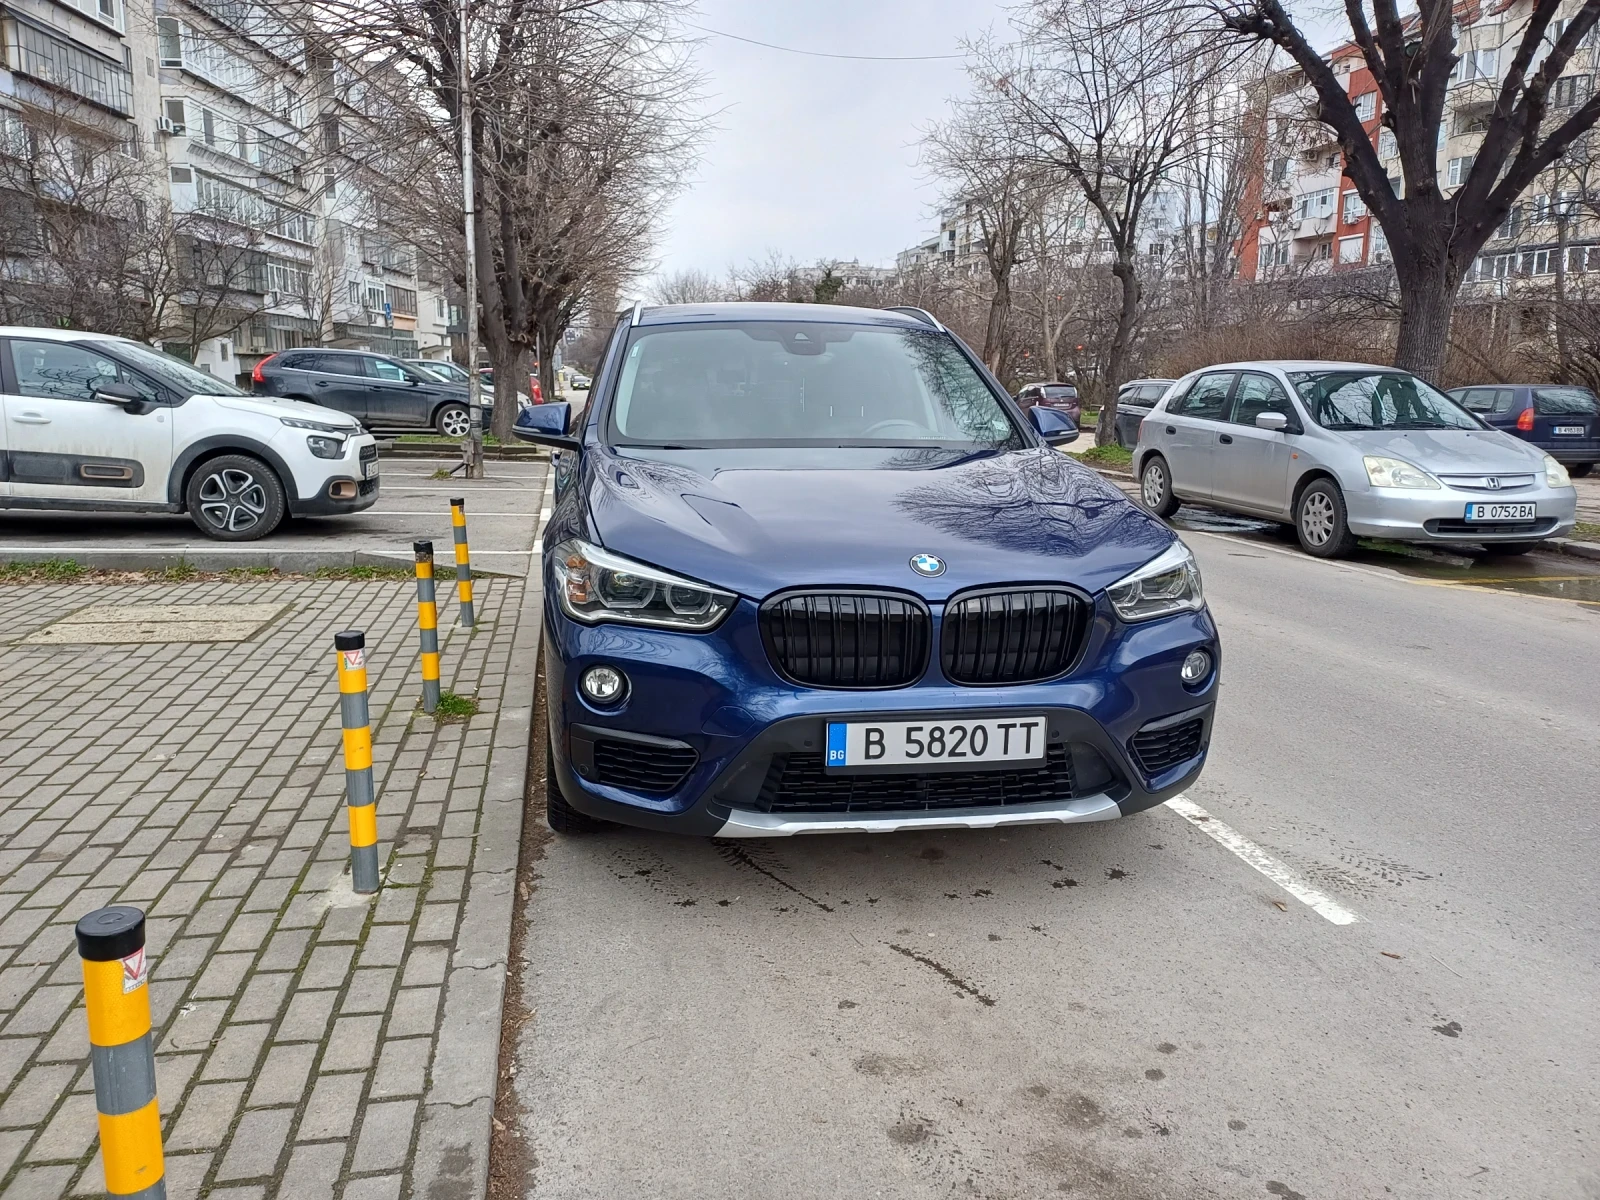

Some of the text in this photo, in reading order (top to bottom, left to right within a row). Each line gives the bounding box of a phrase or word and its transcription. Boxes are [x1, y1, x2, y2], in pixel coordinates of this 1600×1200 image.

[1477, 506, 1485, 518] B
[1491, 506, 1518, 518] 0752
[1519, 506, 1533, 518] BA
[829, 722, 1039, 760] BG B 5820 TT
